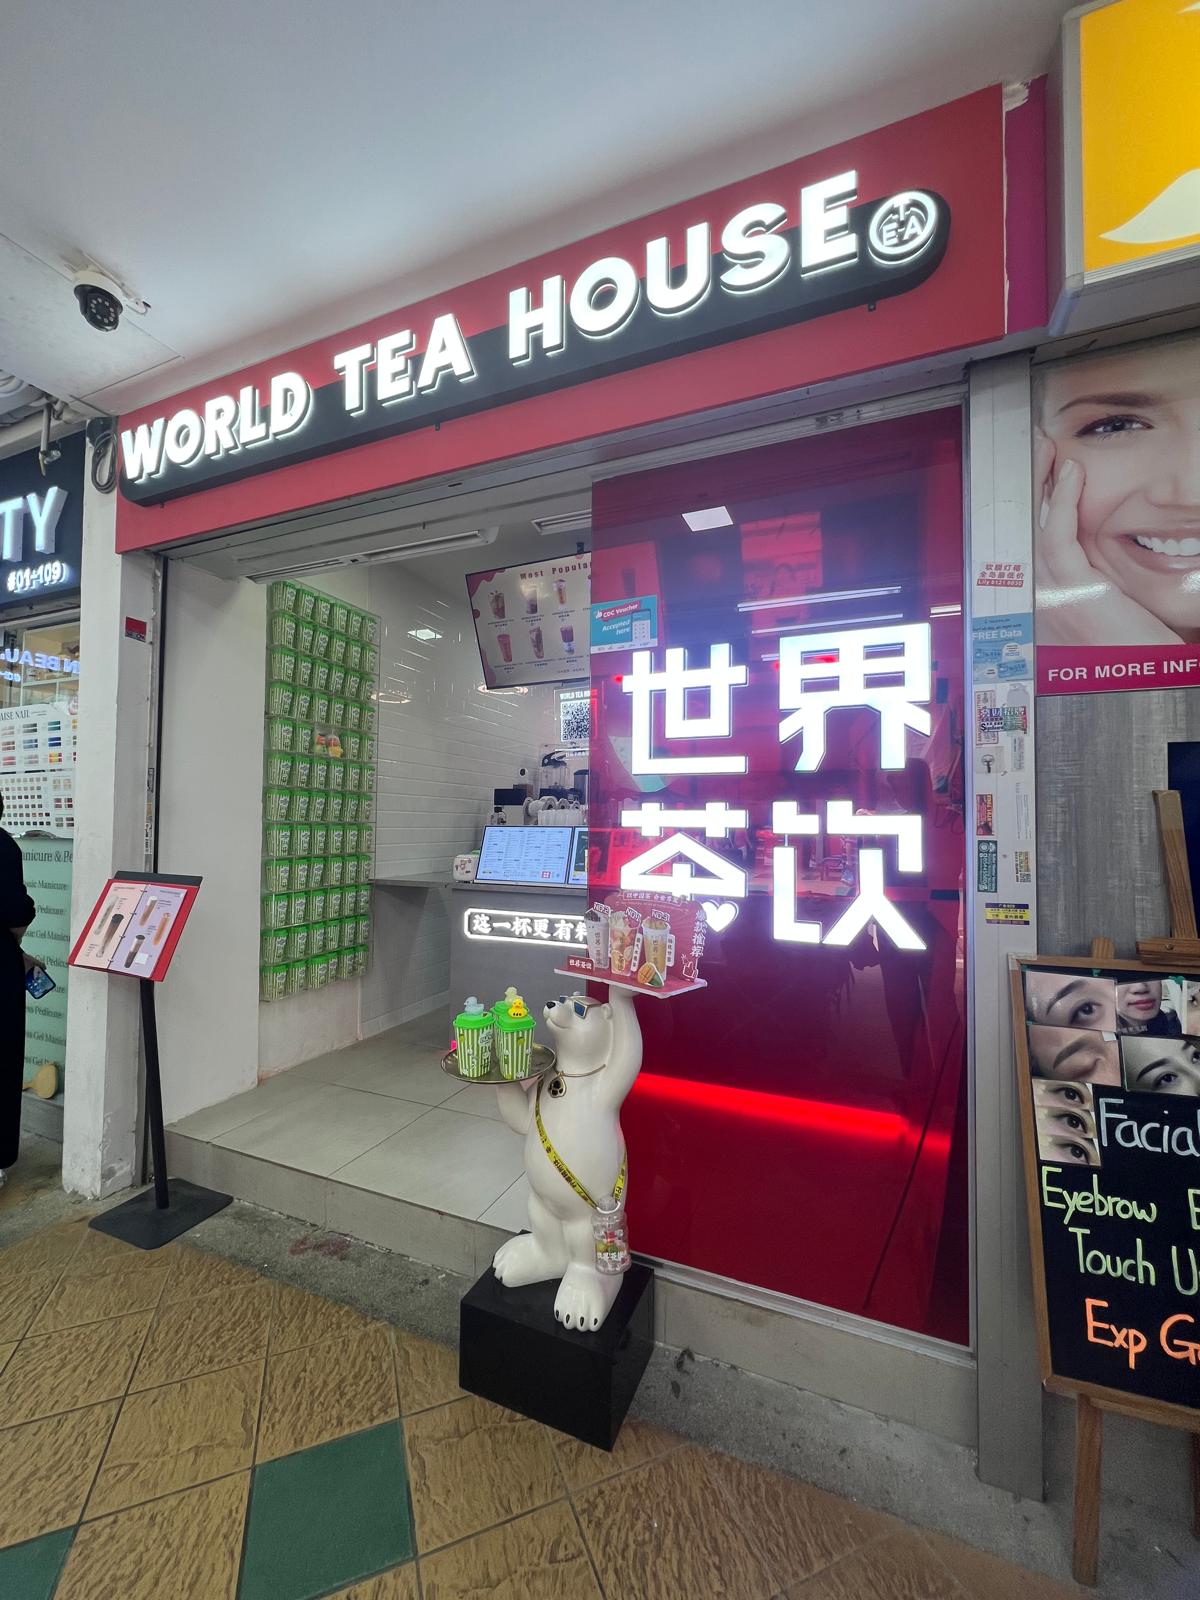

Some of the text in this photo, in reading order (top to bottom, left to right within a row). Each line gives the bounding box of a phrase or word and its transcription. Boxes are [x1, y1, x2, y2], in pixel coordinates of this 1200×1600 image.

[121, 170, 858, 482] WORLD TEA HOUSE
[520, 570, 544, 580] Most
[603, 604, 638, 618] CDC Voucher
[602, 620, 631, 632] Accepted
[616, 627, 631, 635] here
[973, 629, 1022, 640] FREE Data
[1048, 659, 1200, 682] FOR MORE INF
[620, 622, 934, 776] 世界
[22, 850, 53, 862] anicure
[54, 851, 61, 862] &
[620, 799, 928, 951] 茶饮
[39, 880, 67, 890] Manicure
[47, 931, 70, 942] Manicu
[46, 956, 68, 968] Pedicu
[1041, 1165, 1157, 1224] Eyebrow
[1068, 1227, 1200, 1296] Touch U
[1085, 1298, 1200, 1369] Exp G
